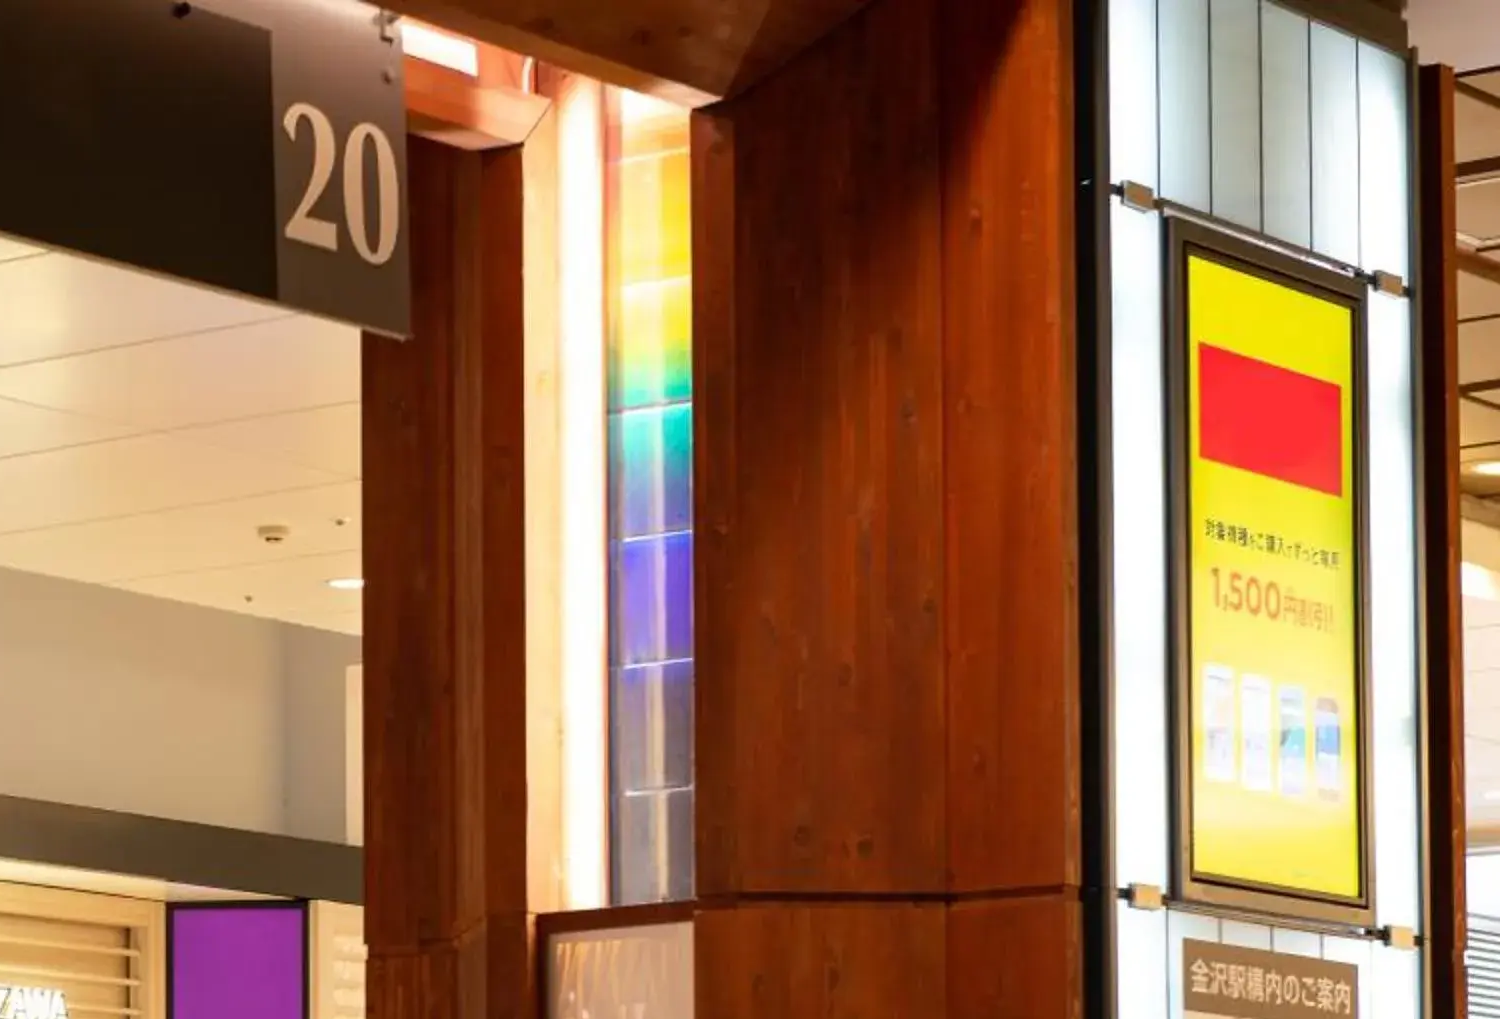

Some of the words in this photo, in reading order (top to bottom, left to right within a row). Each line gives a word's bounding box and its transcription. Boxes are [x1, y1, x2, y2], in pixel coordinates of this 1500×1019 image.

[283, 102, 400, 266] 20
[1190, 957, 1352, 1016] 金沢駅構内のご案内
